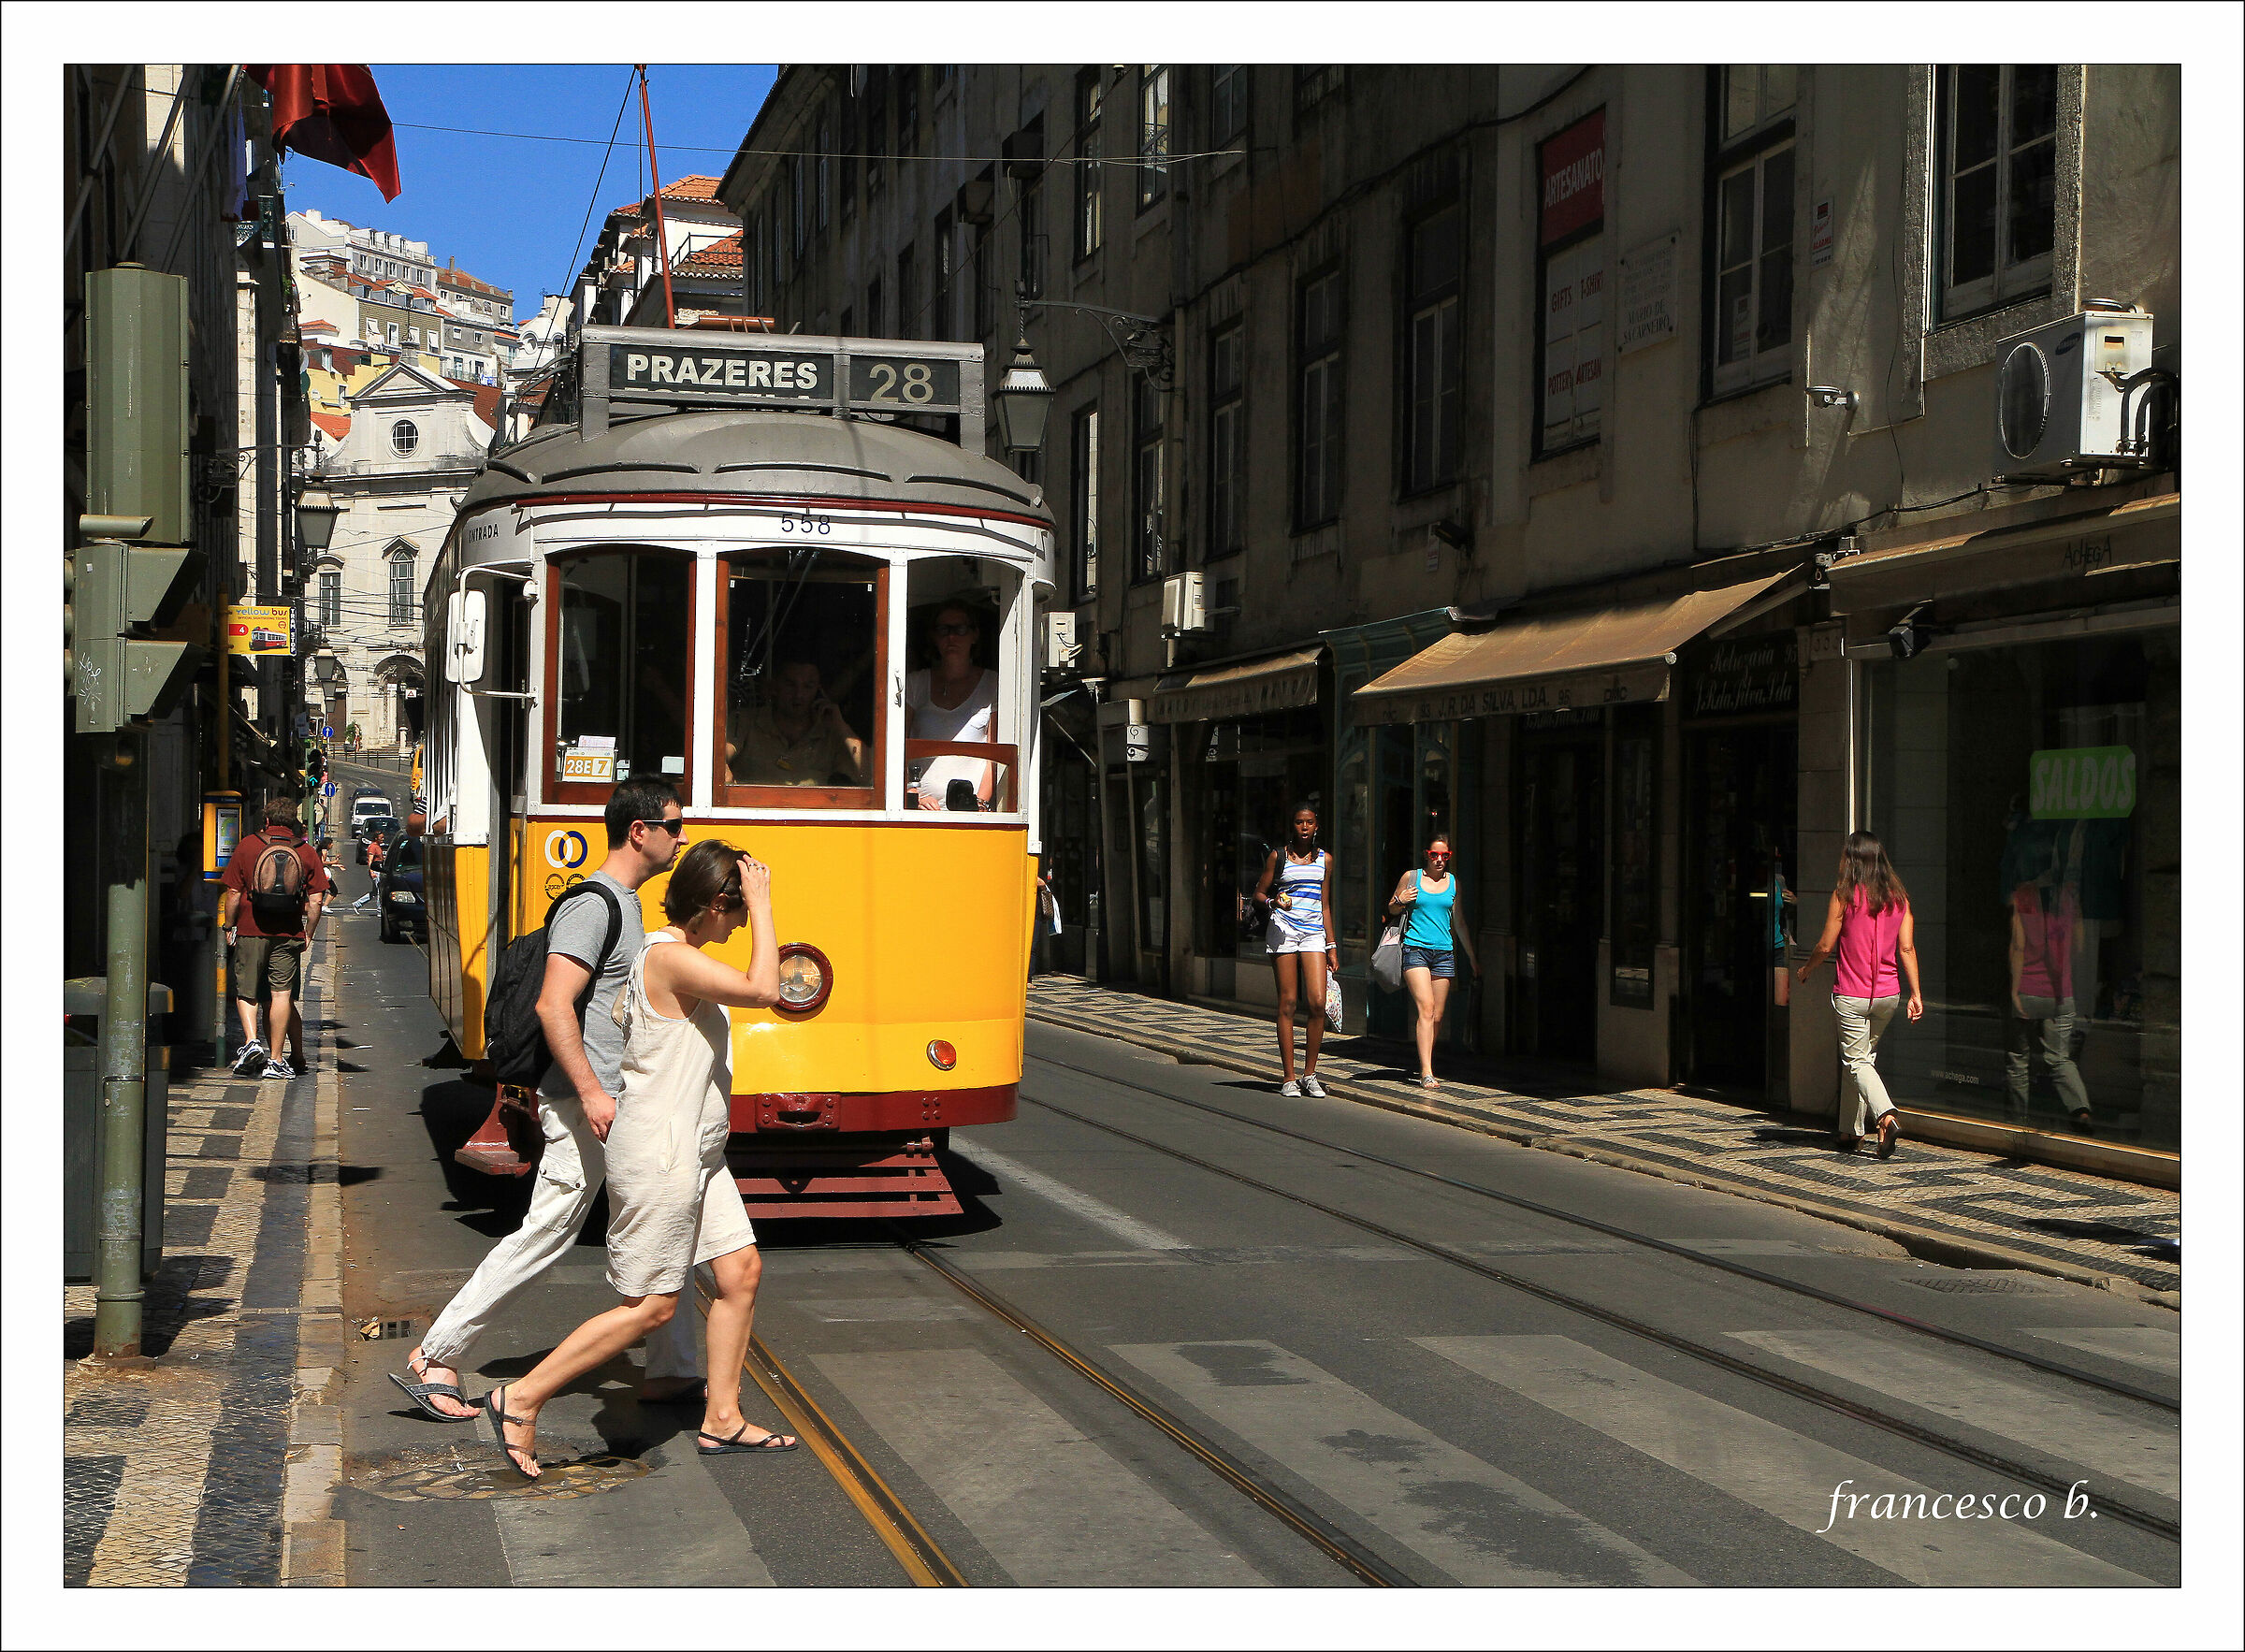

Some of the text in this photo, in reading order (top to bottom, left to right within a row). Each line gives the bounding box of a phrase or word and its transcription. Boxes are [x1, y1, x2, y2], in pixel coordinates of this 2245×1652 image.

[1543, 148, 1603, 210] ARTESANATO
[1552, 285, 1572, 313] GIFTS
[627, 353, 818, 389] PRAZERES
[869, 363, 934, 403] 28
[781, 514, 831, 535] 558
[271, 607, 287, 616] bus
[566, 759, 591, 774] 28E
[598, 760, 608, 775] 7
[2033, 754, 2136, 811] SALDOS
